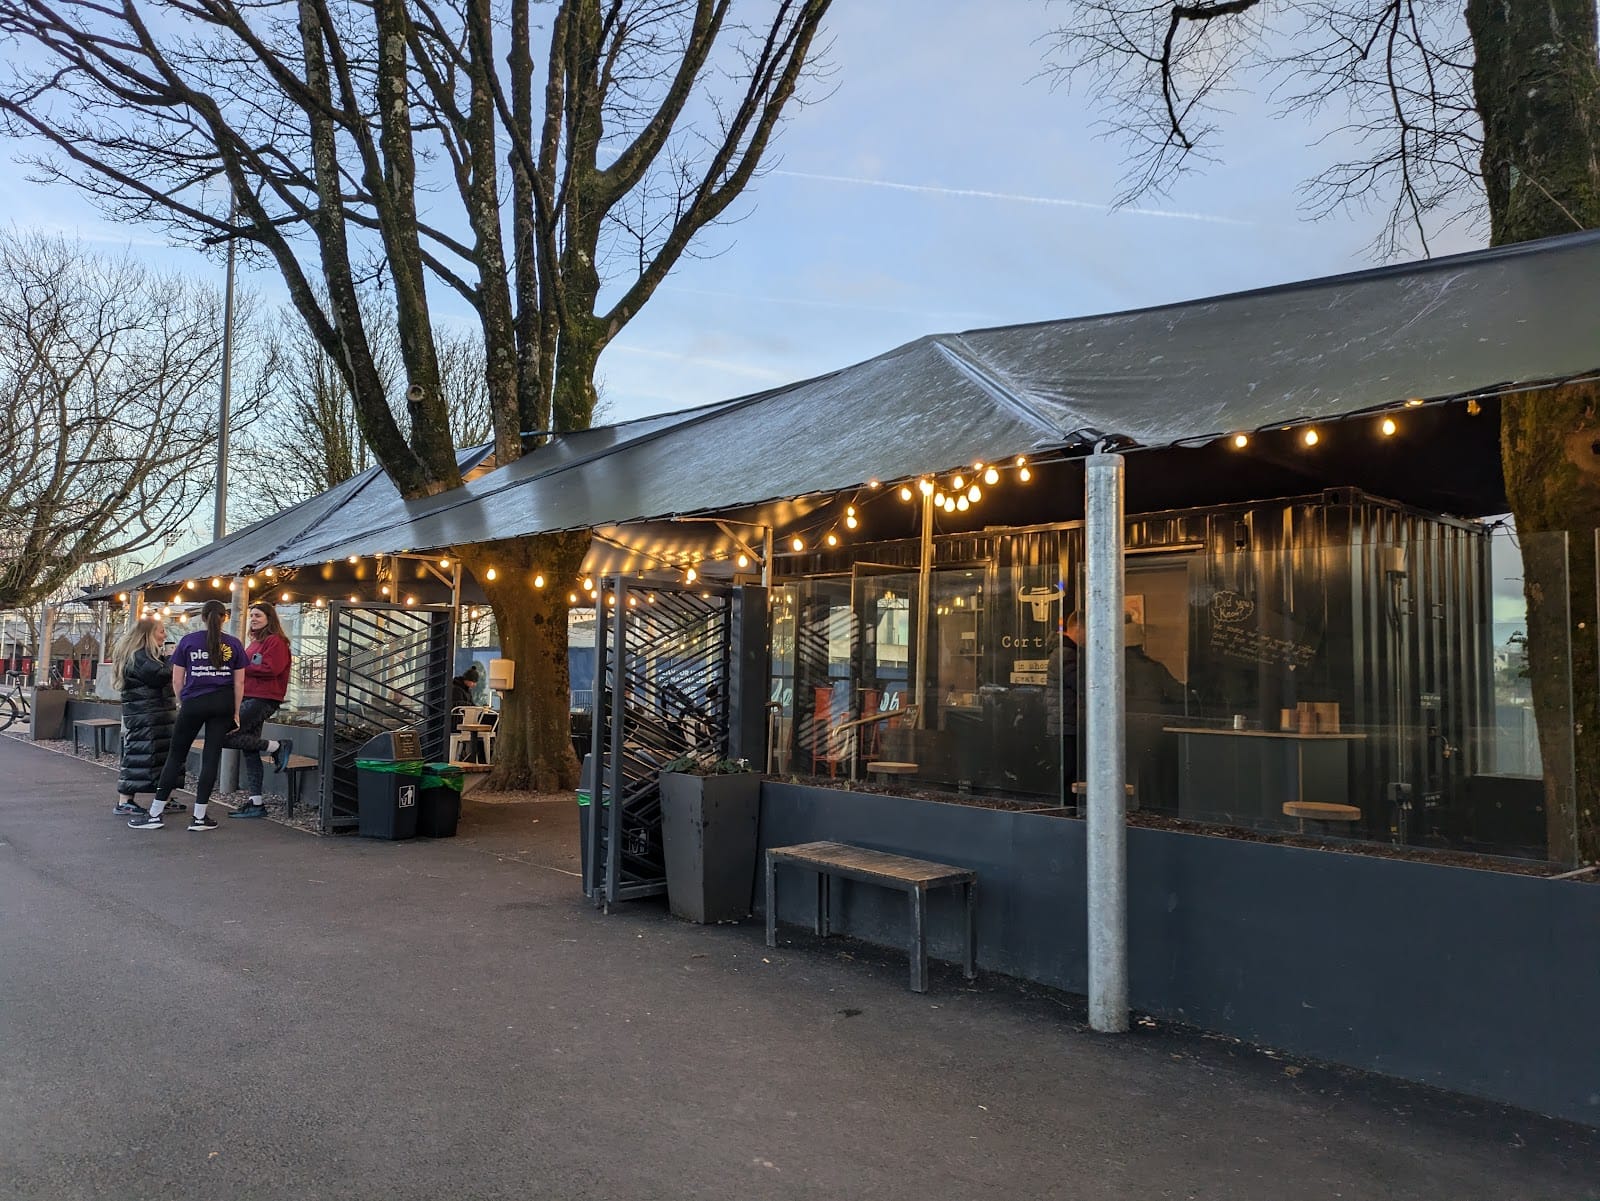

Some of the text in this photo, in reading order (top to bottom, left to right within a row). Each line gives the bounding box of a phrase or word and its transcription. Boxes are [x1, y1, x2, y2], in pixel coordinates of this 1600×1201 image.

[1214, 595, 1251, 609] Did you
[1002, 636, 1048, 648] Cort
